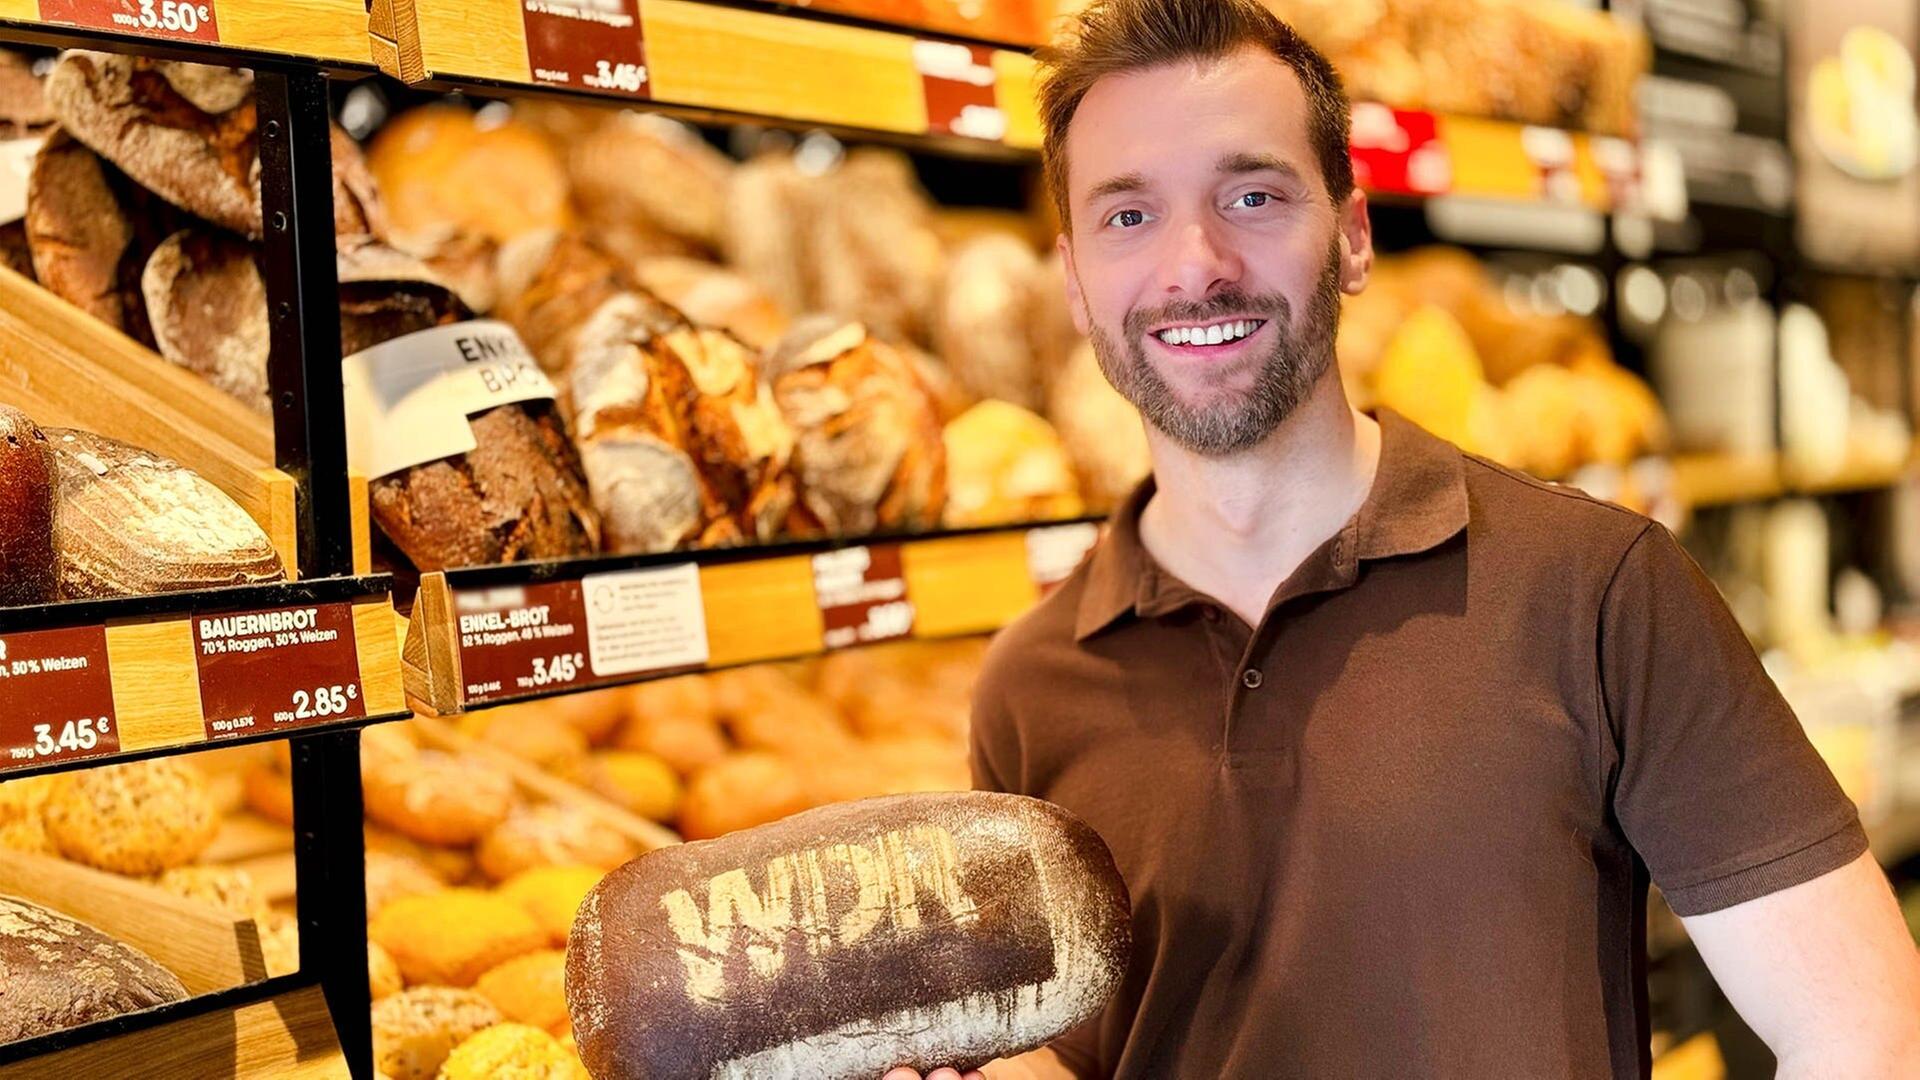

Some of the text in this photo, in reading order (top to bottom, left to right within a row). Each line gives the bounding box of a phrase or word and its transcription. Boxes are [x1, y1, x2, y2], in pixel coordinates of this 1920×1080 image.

[199, 608, 318, 640] BAUERNBROT
[459, 605, 550, 634] ENKEL-BROT
[227, 635, 275, 653] Roggen,
[299, 629, 338, 644] Weizen
[41, 656, 88, 672] Weizen
